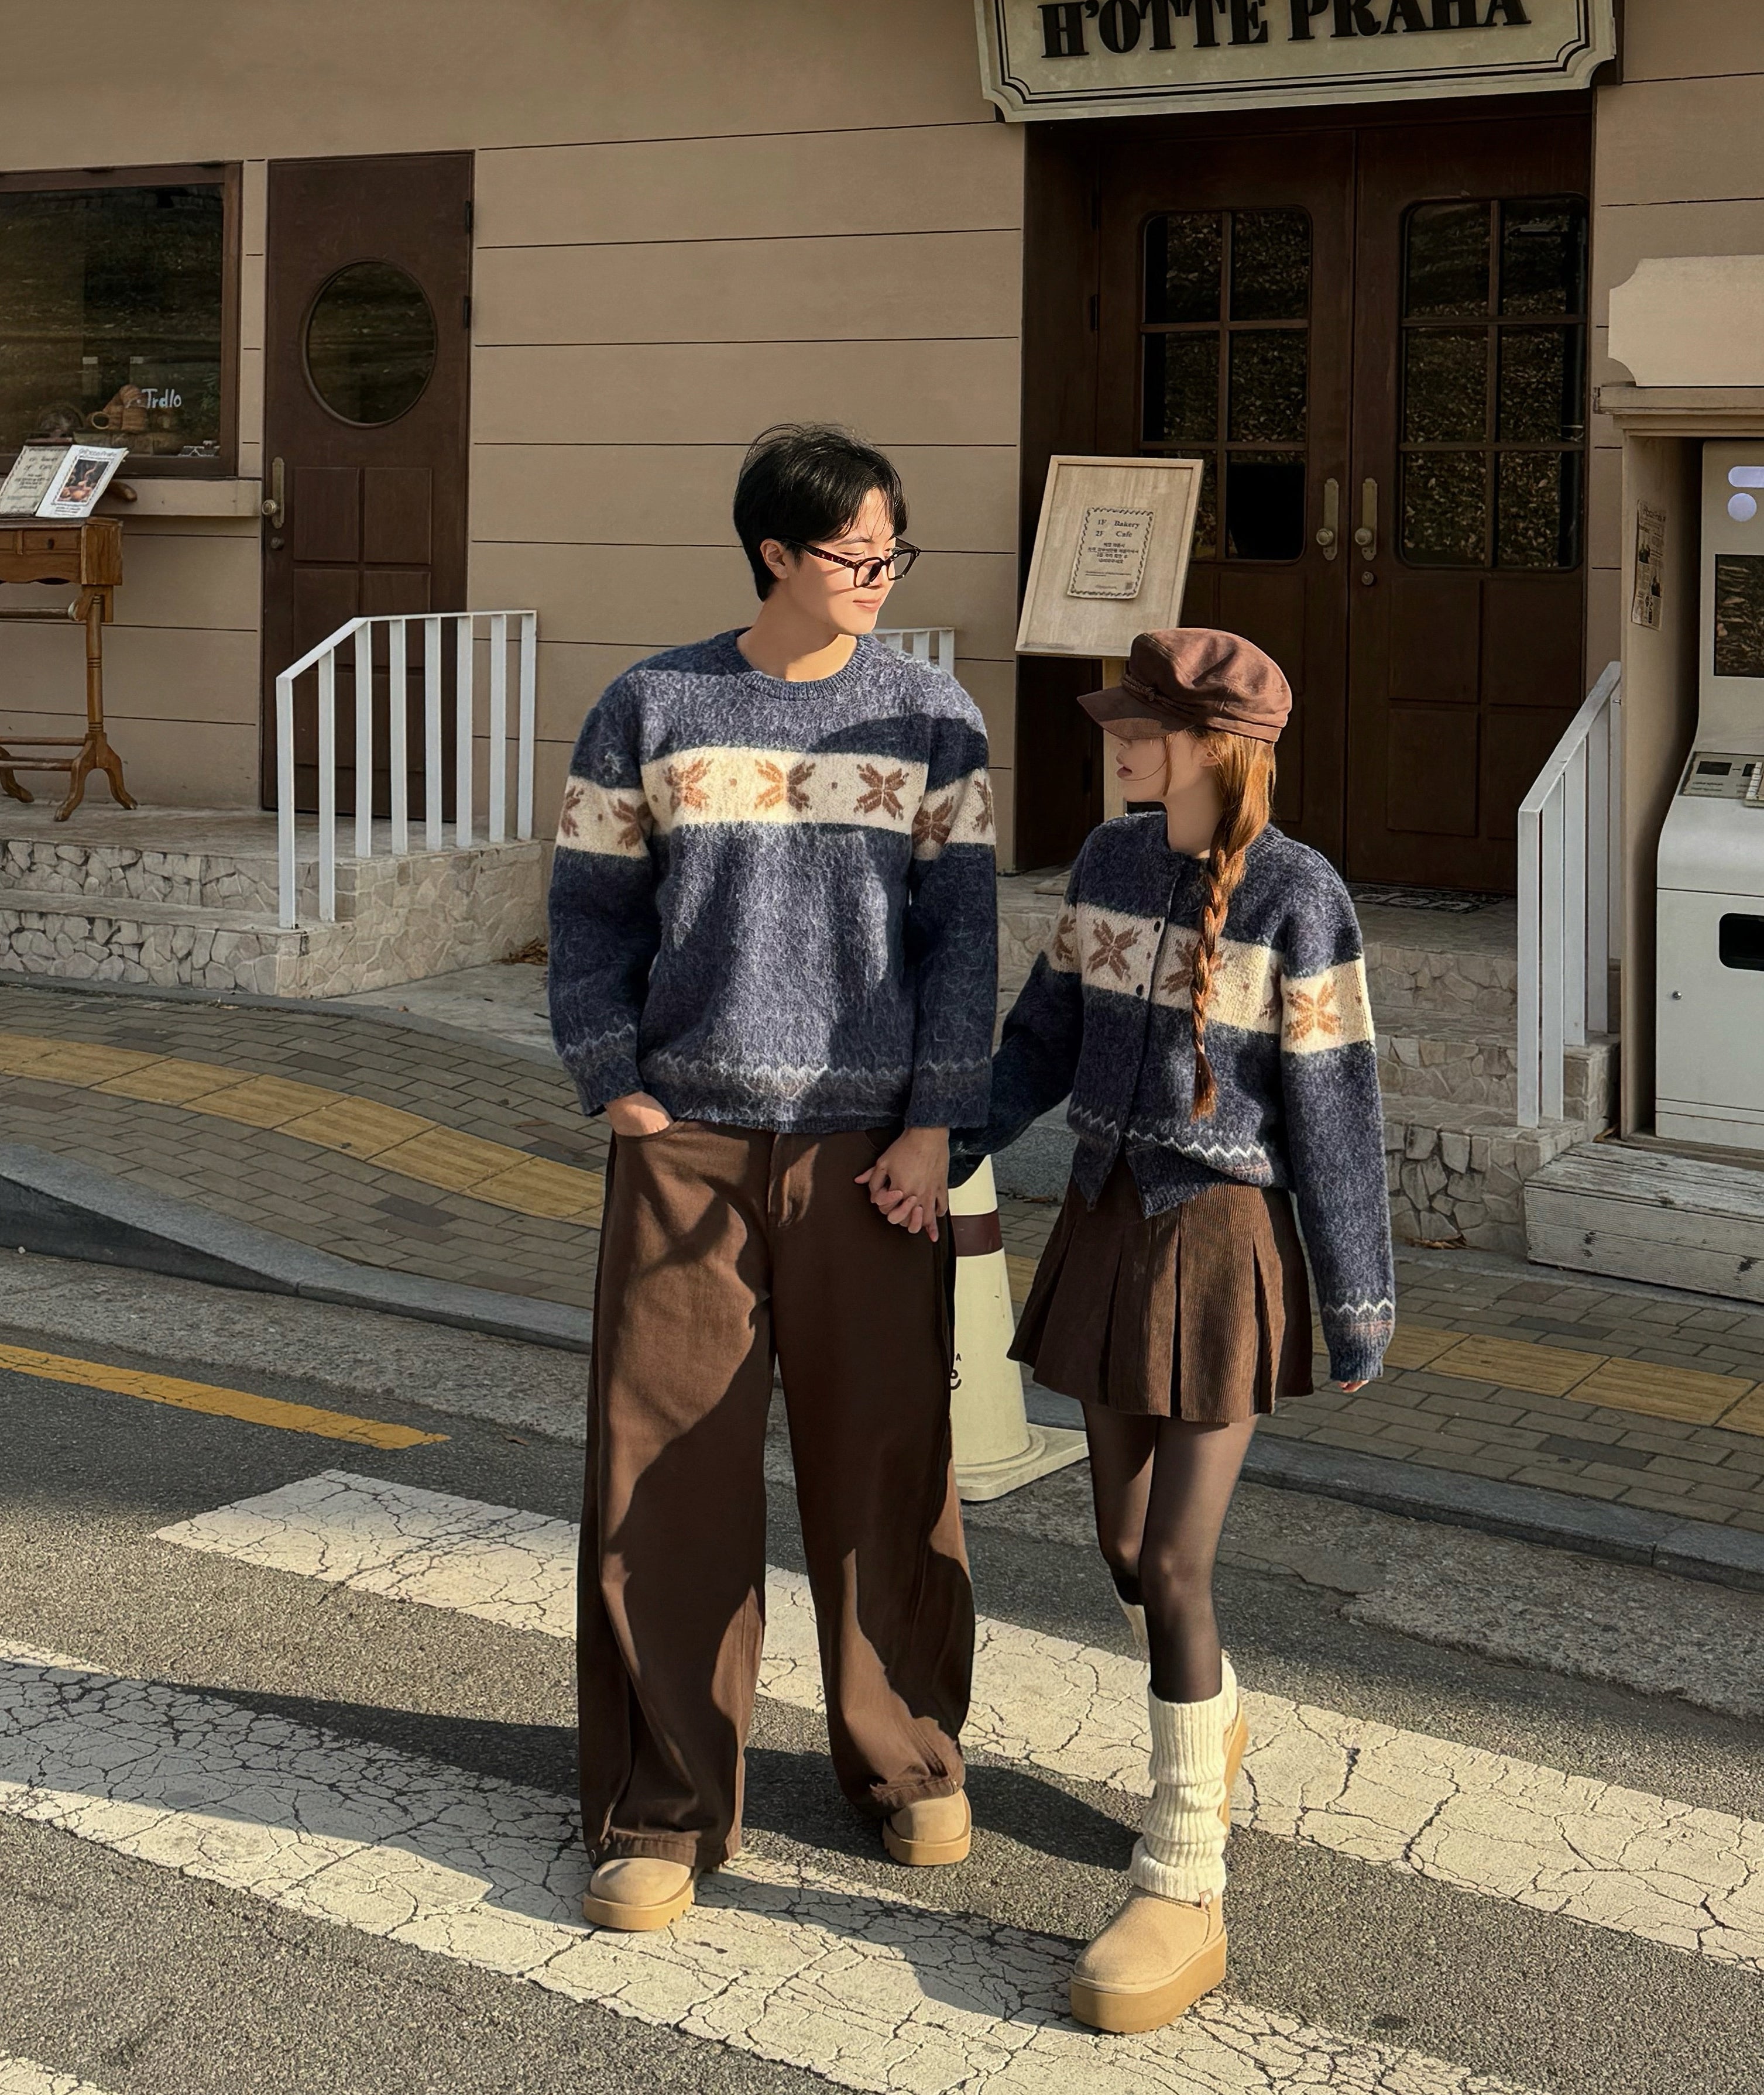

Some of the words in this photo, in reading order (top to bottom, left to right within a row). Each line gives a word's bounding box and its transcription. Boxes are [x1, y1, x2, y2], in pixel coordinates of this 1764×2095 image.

[1037, 0, 1269, 58] H'OTTE
[141, 389, 181, 408] Trdlo
[1114, 520, 1140, 529] Bakery
